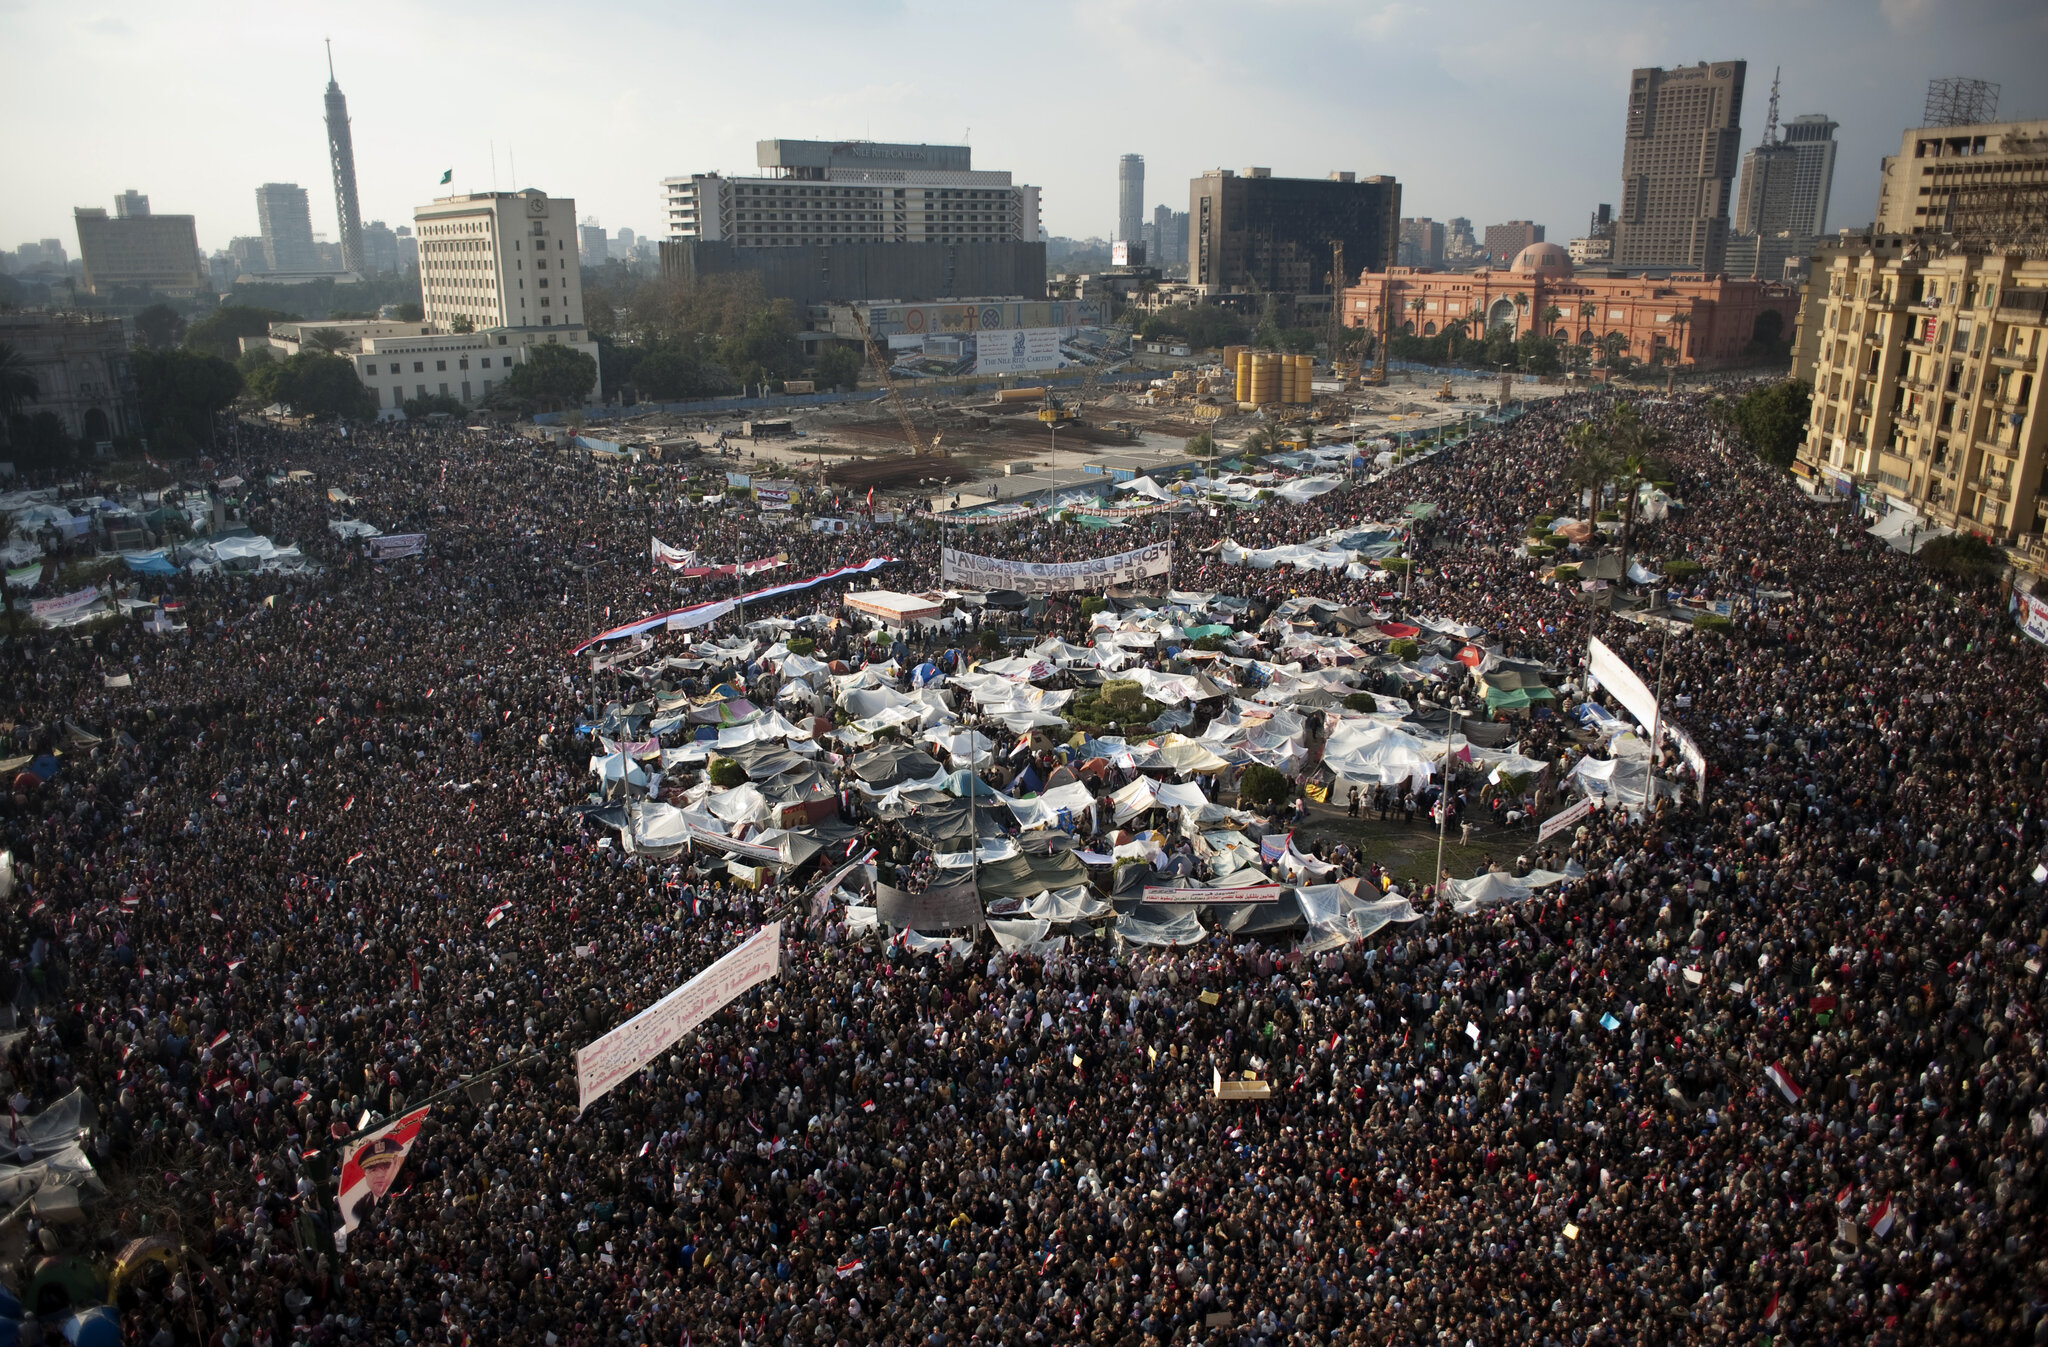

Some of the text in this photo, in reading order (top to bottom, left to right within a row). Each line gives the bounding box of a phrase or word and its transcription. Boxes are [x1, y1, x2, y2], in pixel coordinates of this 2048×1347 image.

[852, 147, 869, 157] NILE
[984, 358, 996, 366] THE
[997, 357, 1011, 365] NILE
